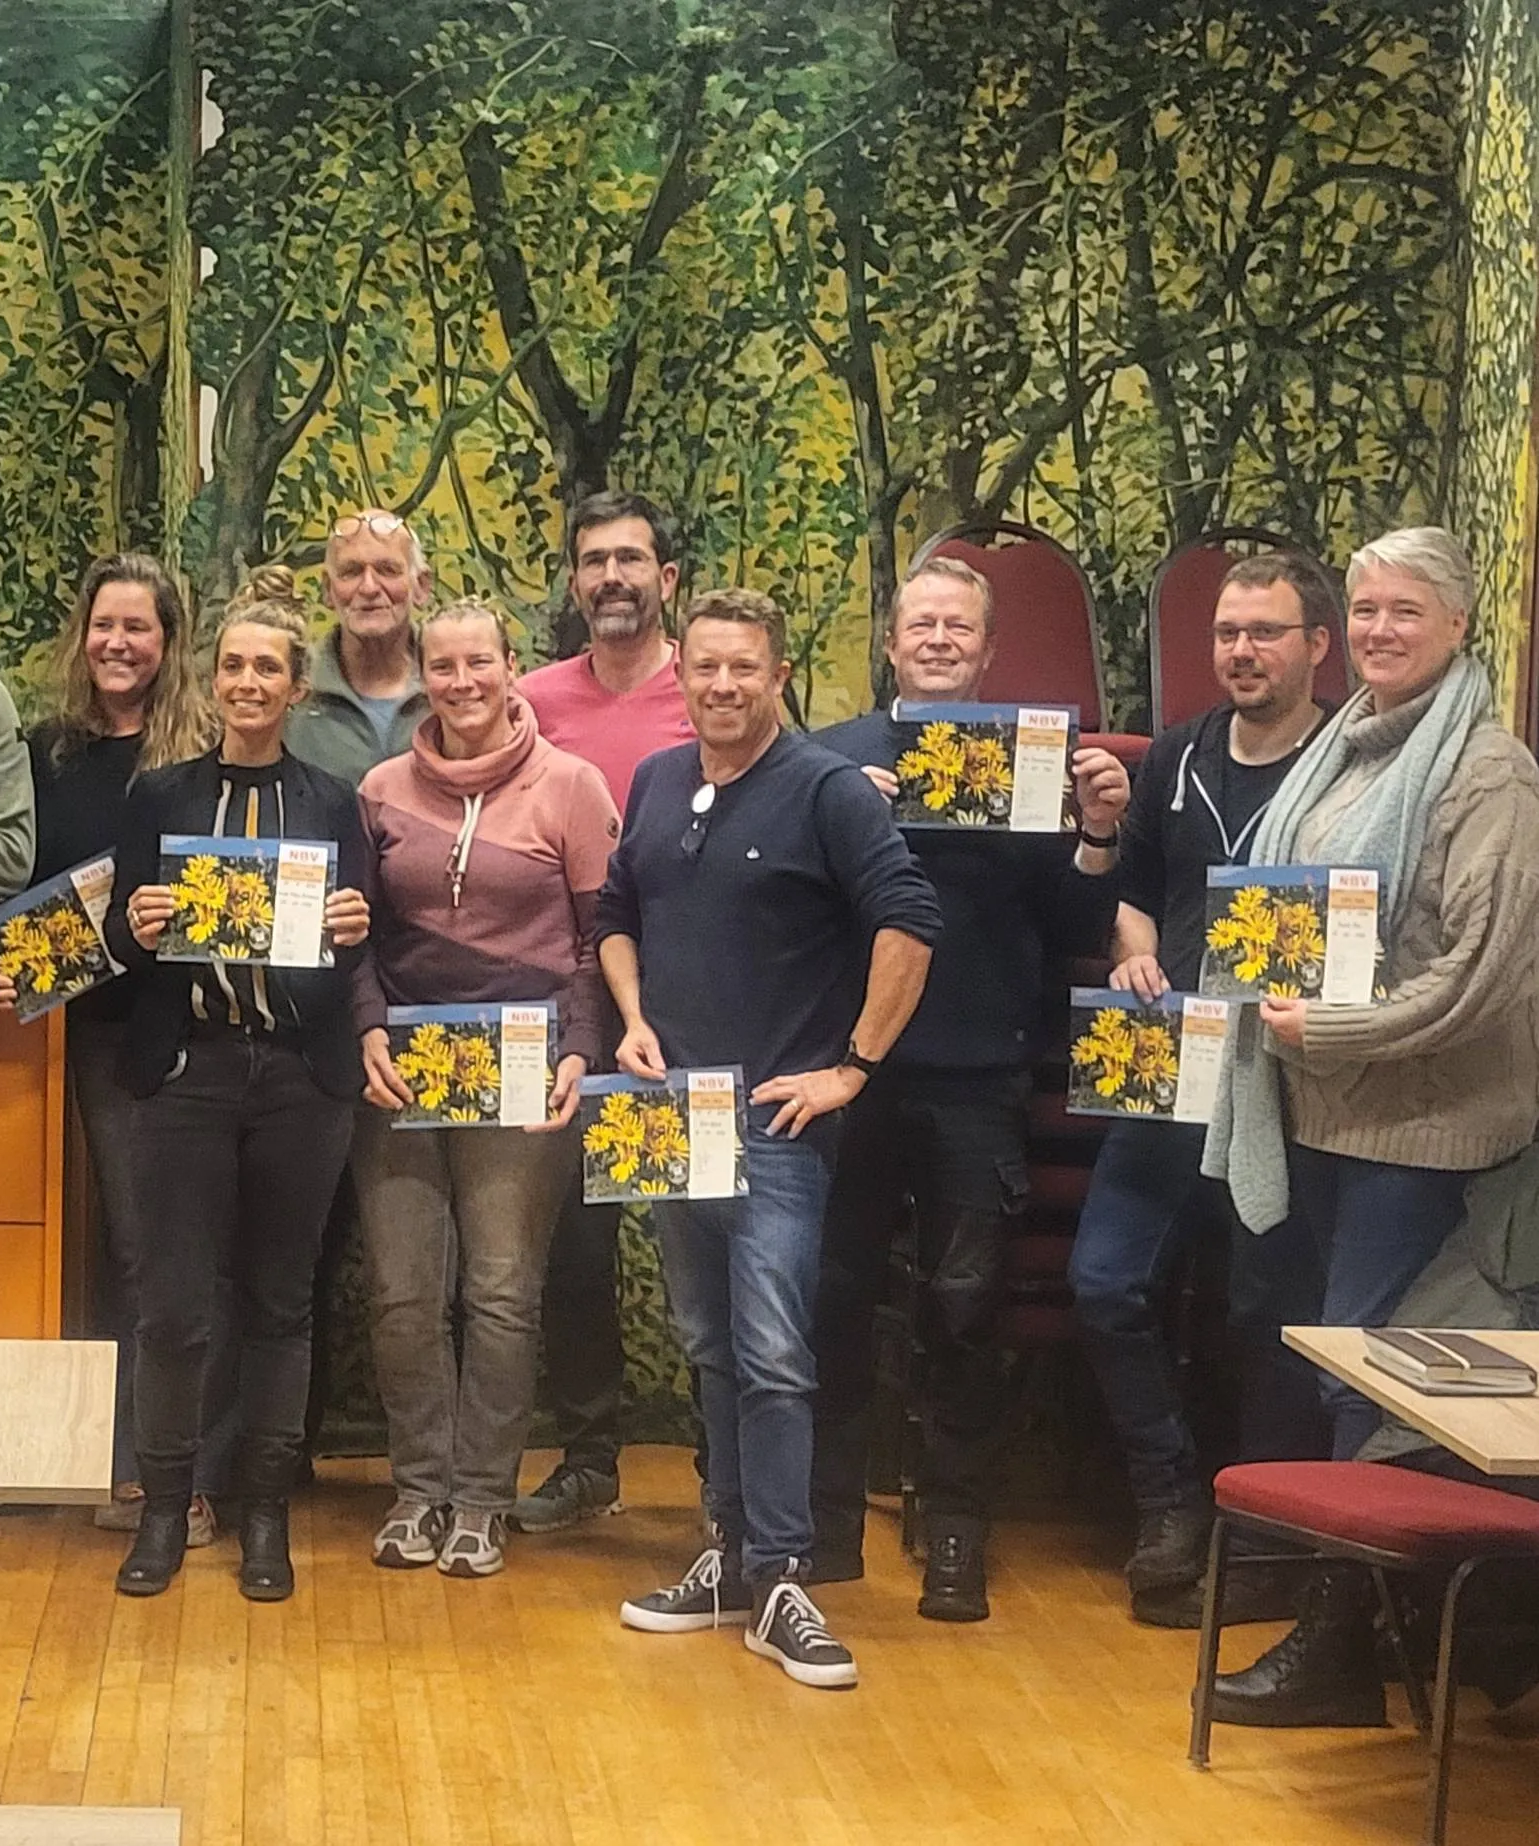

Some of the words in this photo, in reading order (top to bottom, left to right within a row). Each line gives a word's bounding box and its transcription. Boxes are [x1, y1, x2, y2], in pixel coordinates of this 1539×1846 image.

[1028, 715, 1060, 726] NBV
[289, 851, 319, 861] NBV
[1340, 875, 1369, 886] NBV
[512, 1012, 540, 1022] NBV
[698, 1078, 726, 1088] NBV
